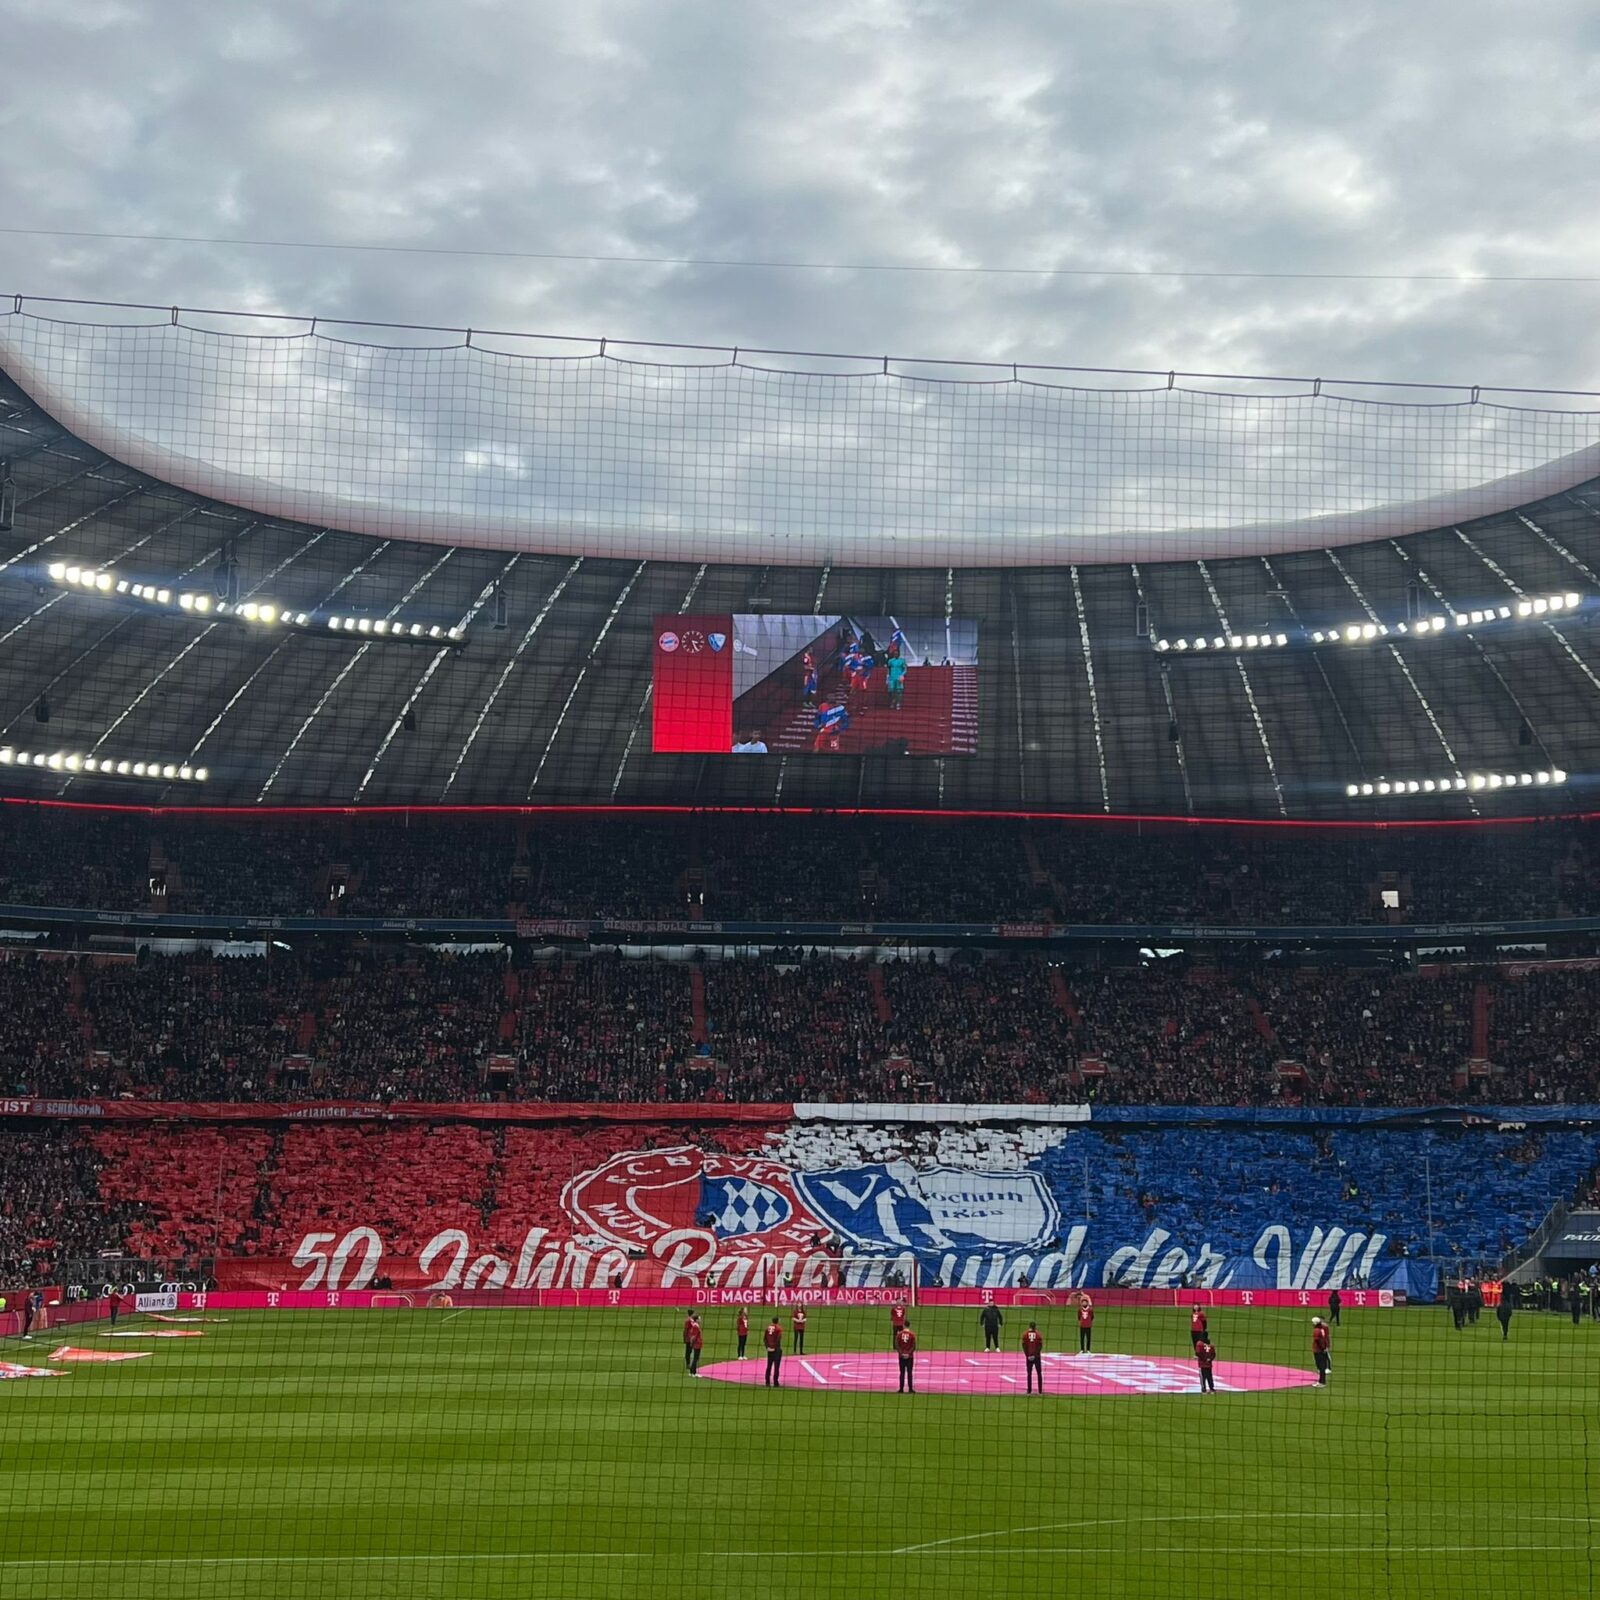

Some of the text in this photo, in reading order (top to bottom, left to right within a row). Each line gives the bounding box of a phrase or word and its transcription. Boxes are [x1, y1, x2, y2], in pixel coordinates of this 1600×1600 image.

[291, 1226, 382, 1290] 50
[137, 1294, 165, 1307] Allianz
[696, 1290, 718, 1303] DIE
